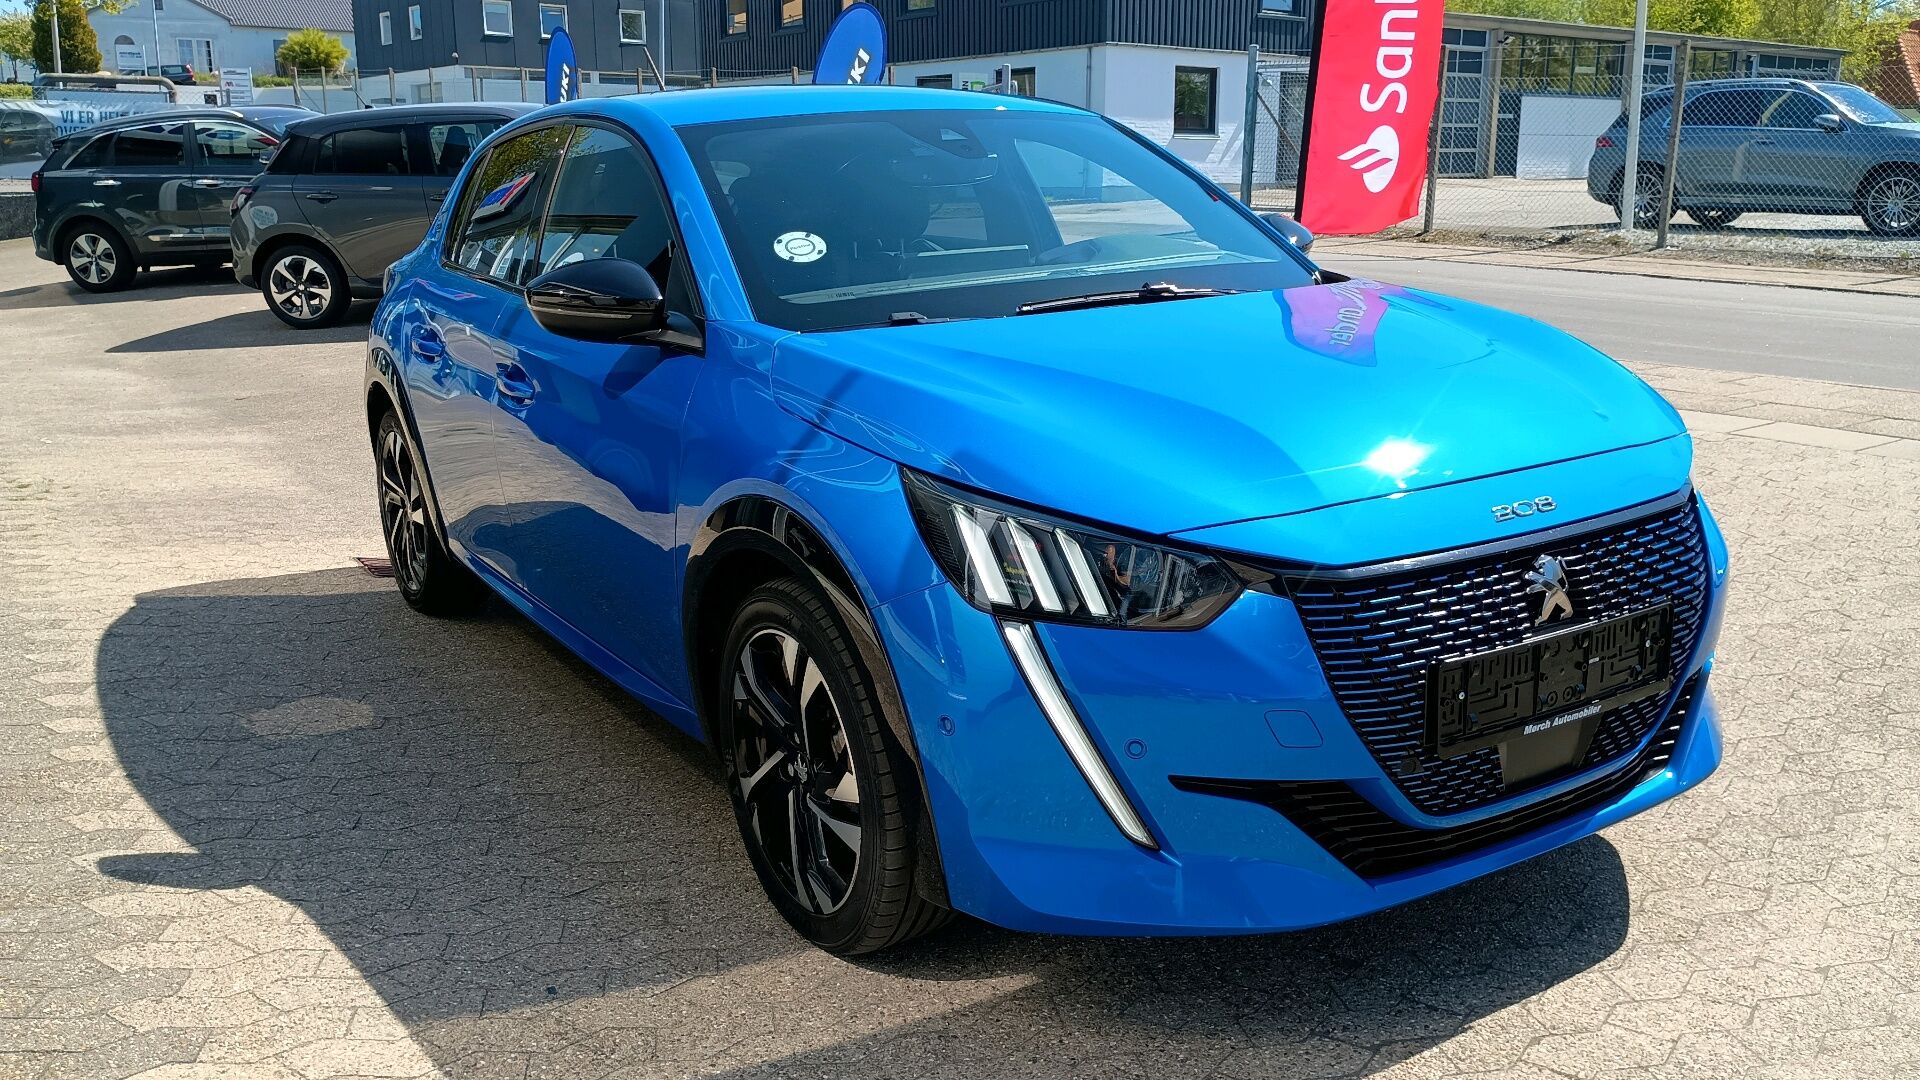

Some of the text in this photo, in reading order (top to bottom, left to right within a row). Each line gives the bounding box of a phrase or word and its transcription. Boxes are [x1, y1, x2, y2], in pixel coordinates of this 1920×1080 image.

[1359, 0, 1419, 113] San
[60, 110, 74, 124] VI
[79, 111, 95, 124] ER
[1491, 496, 1557, 522] 208
[1552, 705, 1602, 727] Automobiler
